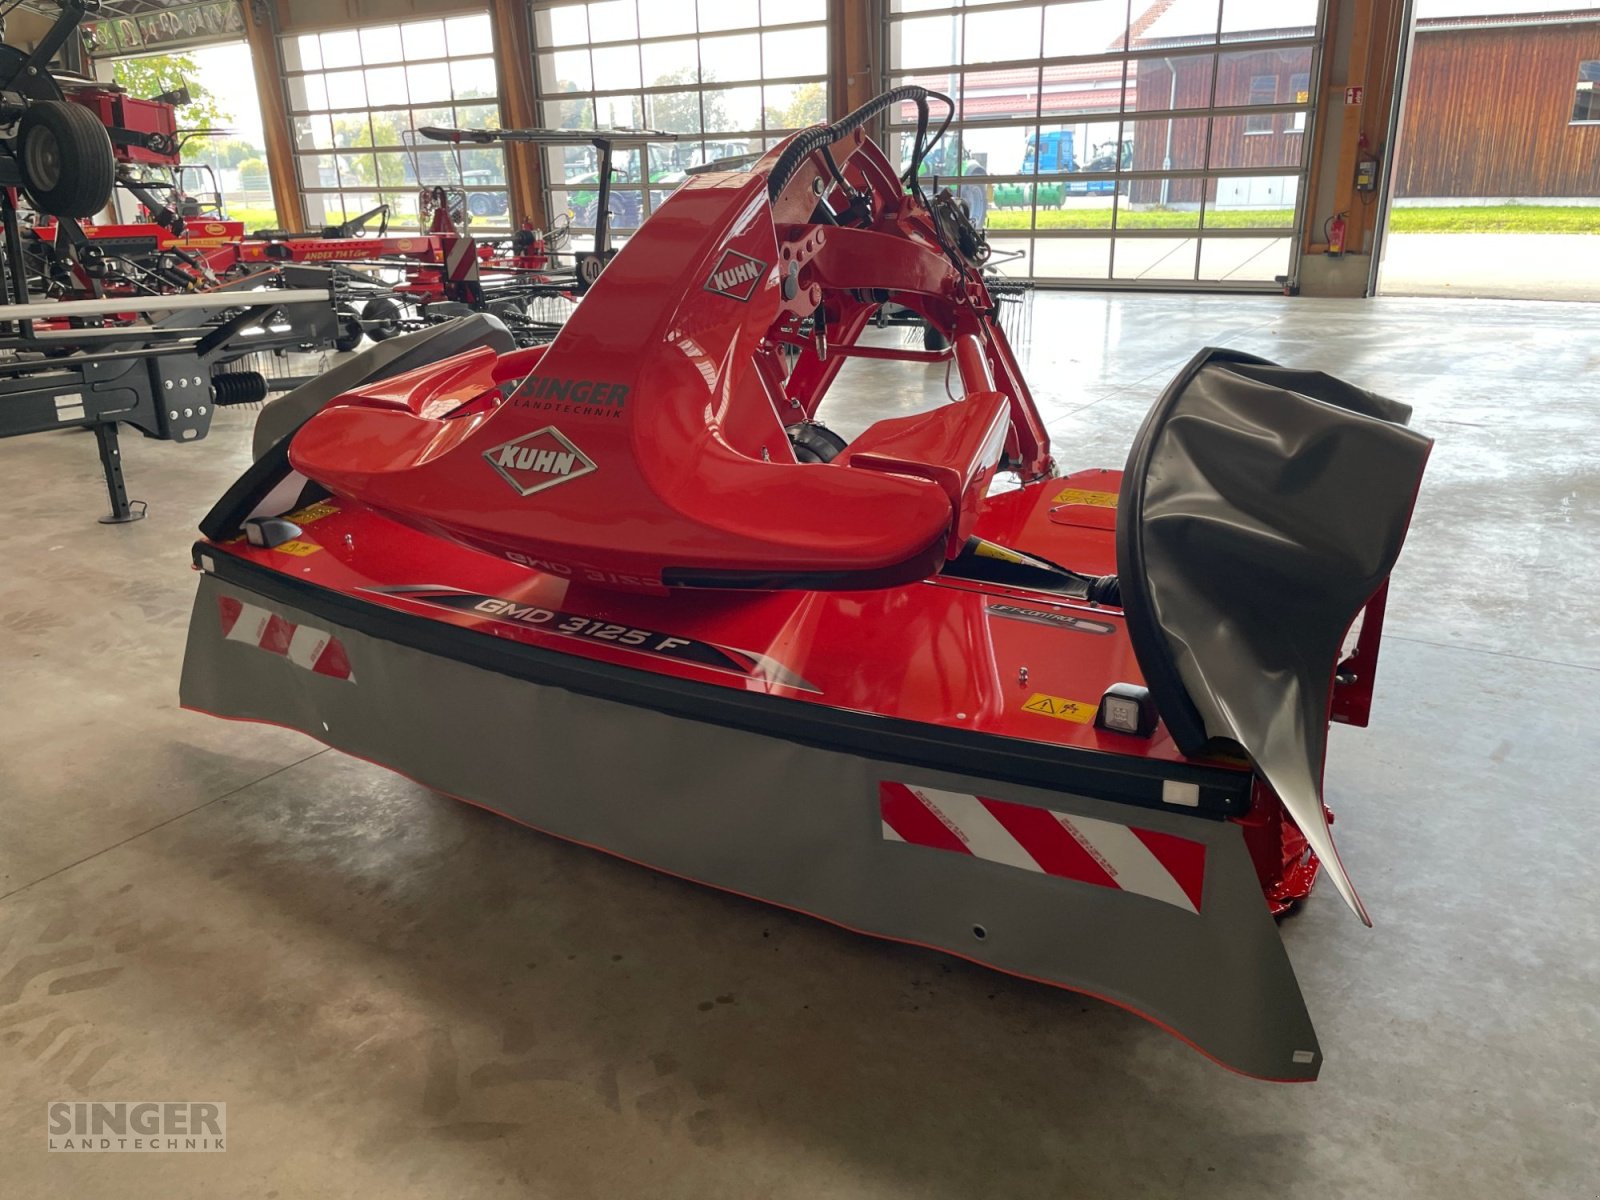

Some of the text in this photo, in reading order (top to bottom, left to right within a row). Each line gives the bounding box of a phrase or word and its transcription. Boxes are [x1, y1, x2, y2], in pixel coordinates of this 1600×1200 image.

[304, 251, 333, 260] ANDEX
[585, 260, 599, 279] 40
[713, 261, 758, 291] KUHN
[519, 376, 630, 408] SINGER
[513, 399, 623, 419] LANDTECHNIK
[498, 445, 576, 475] KUHN
[474, 598, 690, 651] GMD 3125 F
